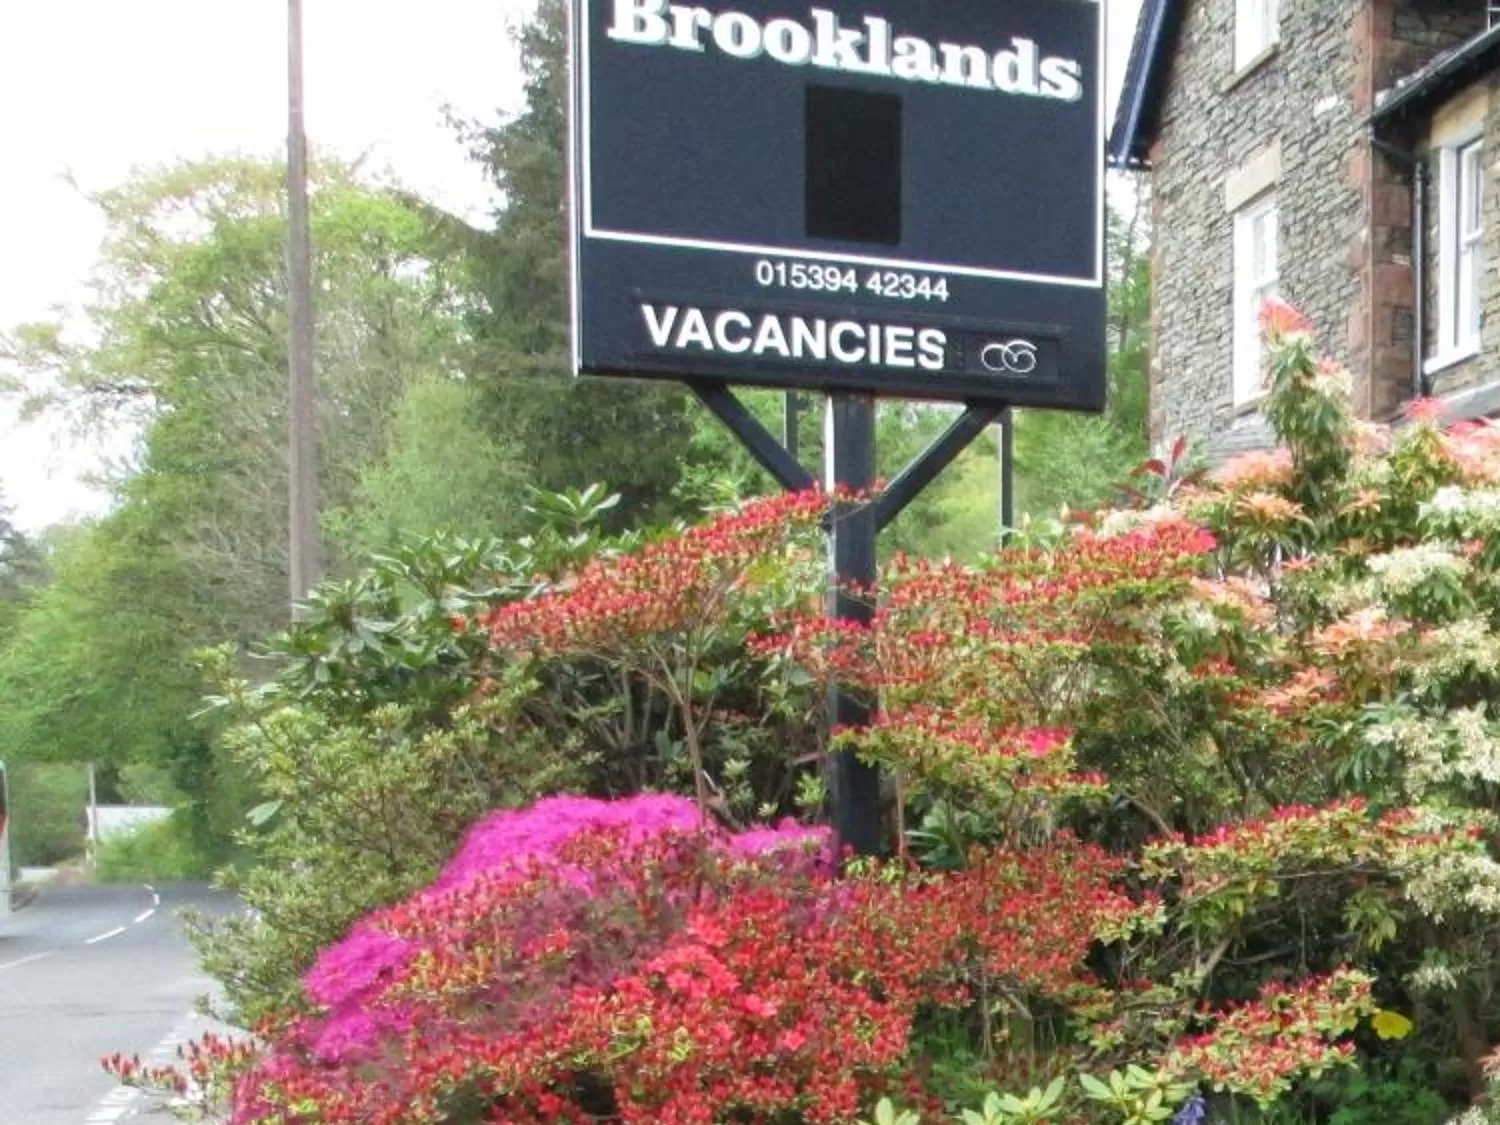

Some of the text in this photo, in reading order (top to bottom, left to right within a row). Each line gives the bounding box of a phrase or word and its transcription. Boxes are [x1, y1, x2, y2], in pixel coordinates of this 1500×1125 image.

[606, 0, 1082, 101] Brooklands
[755, 260, 950, 302] 015394 42344
[641, 303, 948, 370] VACANCIES
